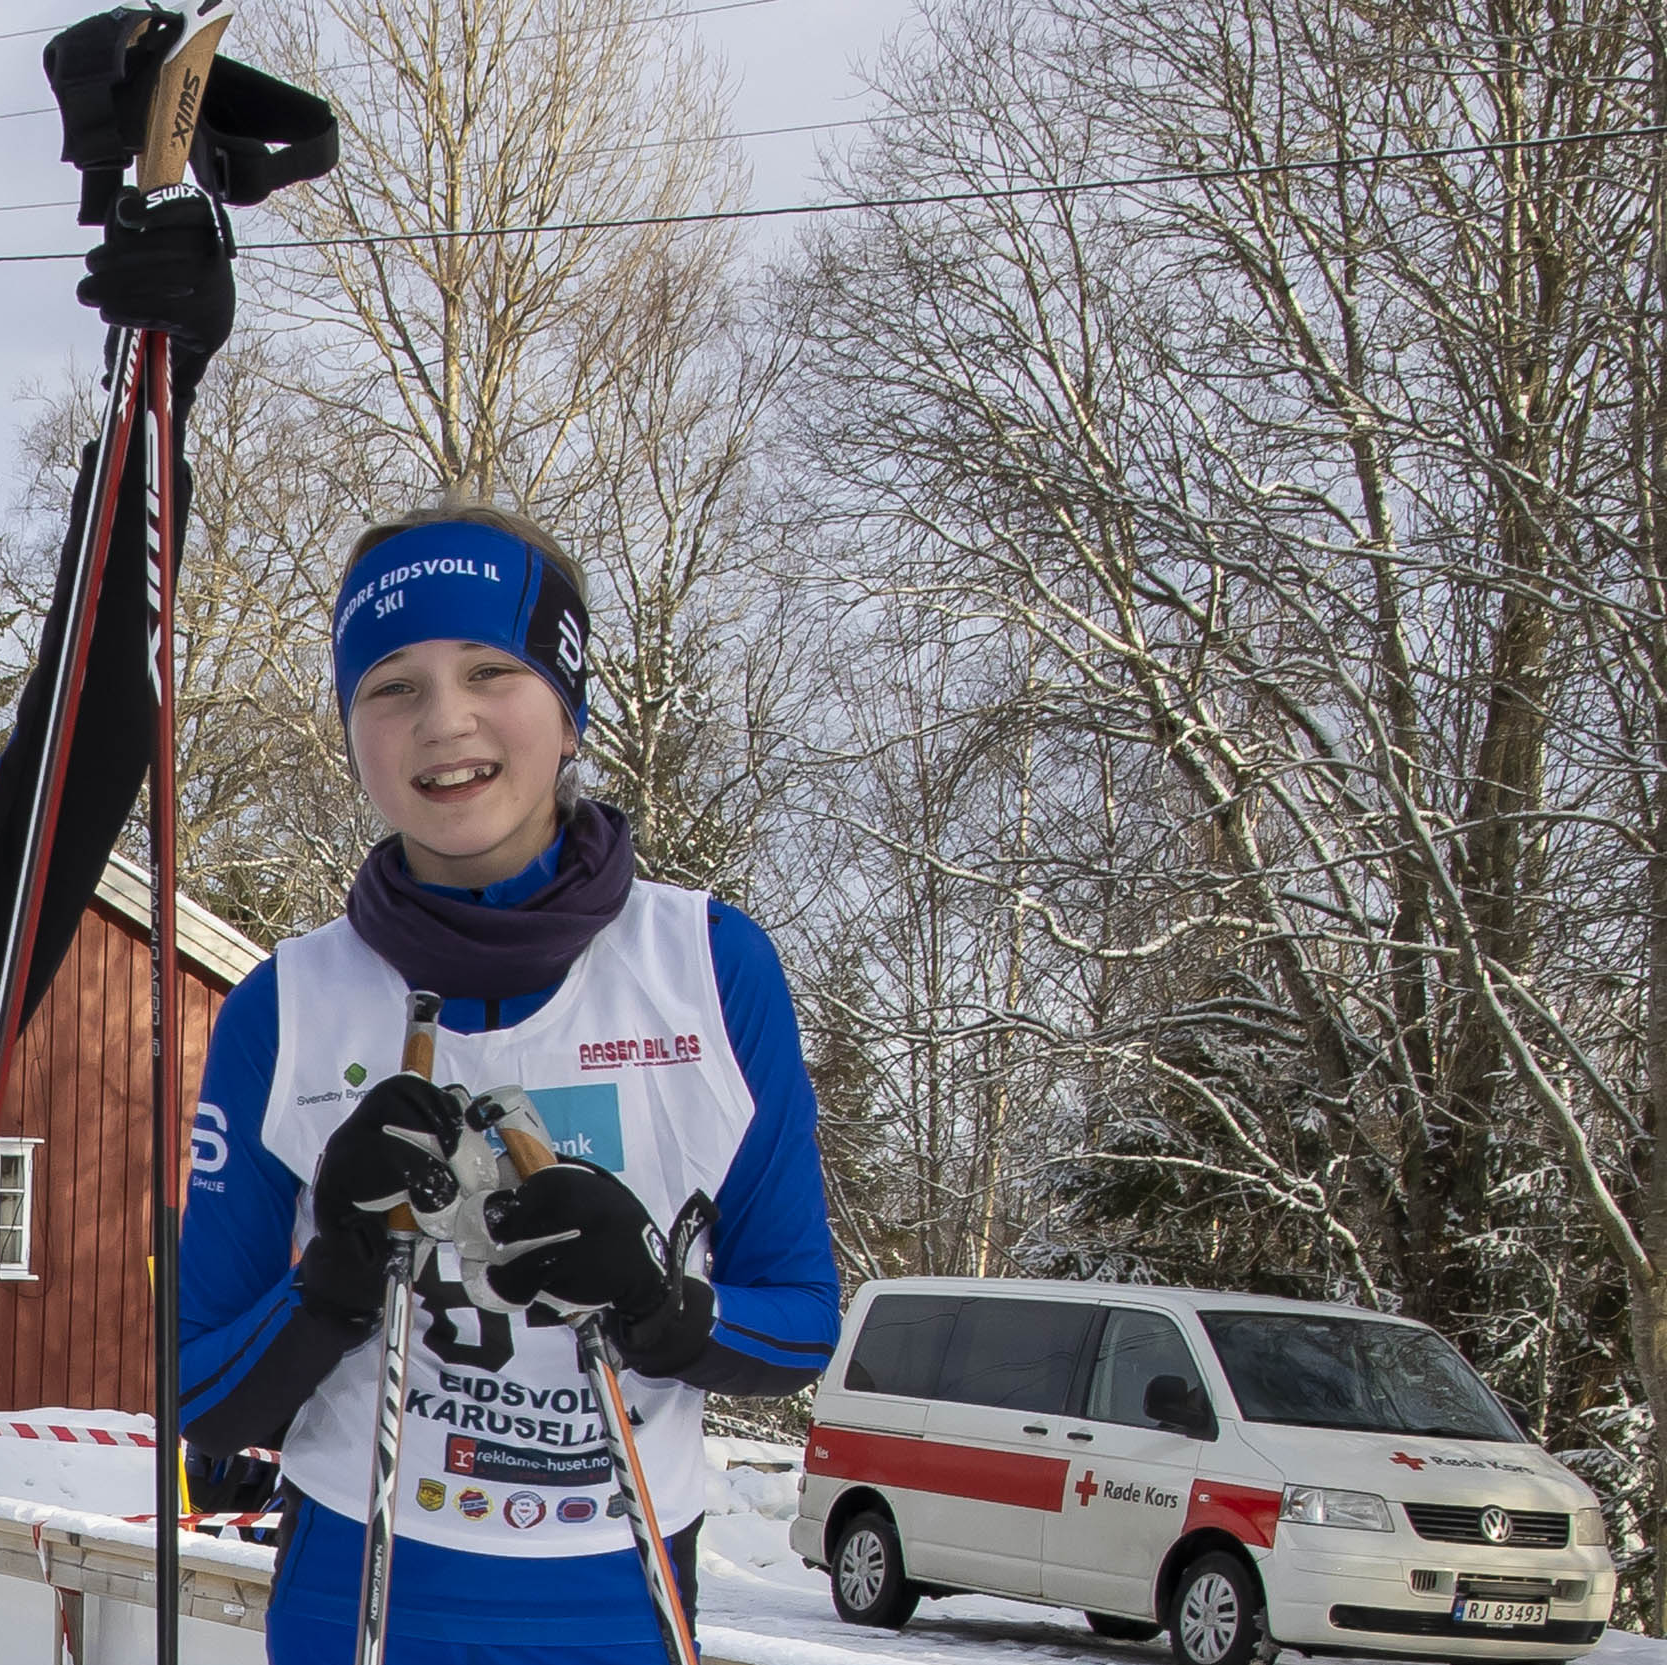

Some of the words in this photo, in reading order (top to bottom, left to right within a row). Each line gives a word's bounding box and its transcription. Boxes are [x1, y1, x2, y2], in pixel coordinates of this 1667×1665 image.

[379, 558, 478, 592] EIDSVOLL
[484, 563, 501, 582] IL
[374, 589, 404, 619] SKI
[579, 1040, 640, 1063] AASEN
[643, 1038, 670, 1059] BIL
[674, 1034, 701, 1060] AS
[296, 1090, 343, 1106] Svendby
[439, 1370, 604, 1415] EIDSVOL
[476, 1449, 611, 1471] reklame-huset.no
[1104, 1481, 1142, 1503] Røde
[1144, 1486, 1179, 1509] Kors
[1468, 1602, 1489, 1621] RJ
[1494, 1604, 1544, 1623] 83493
